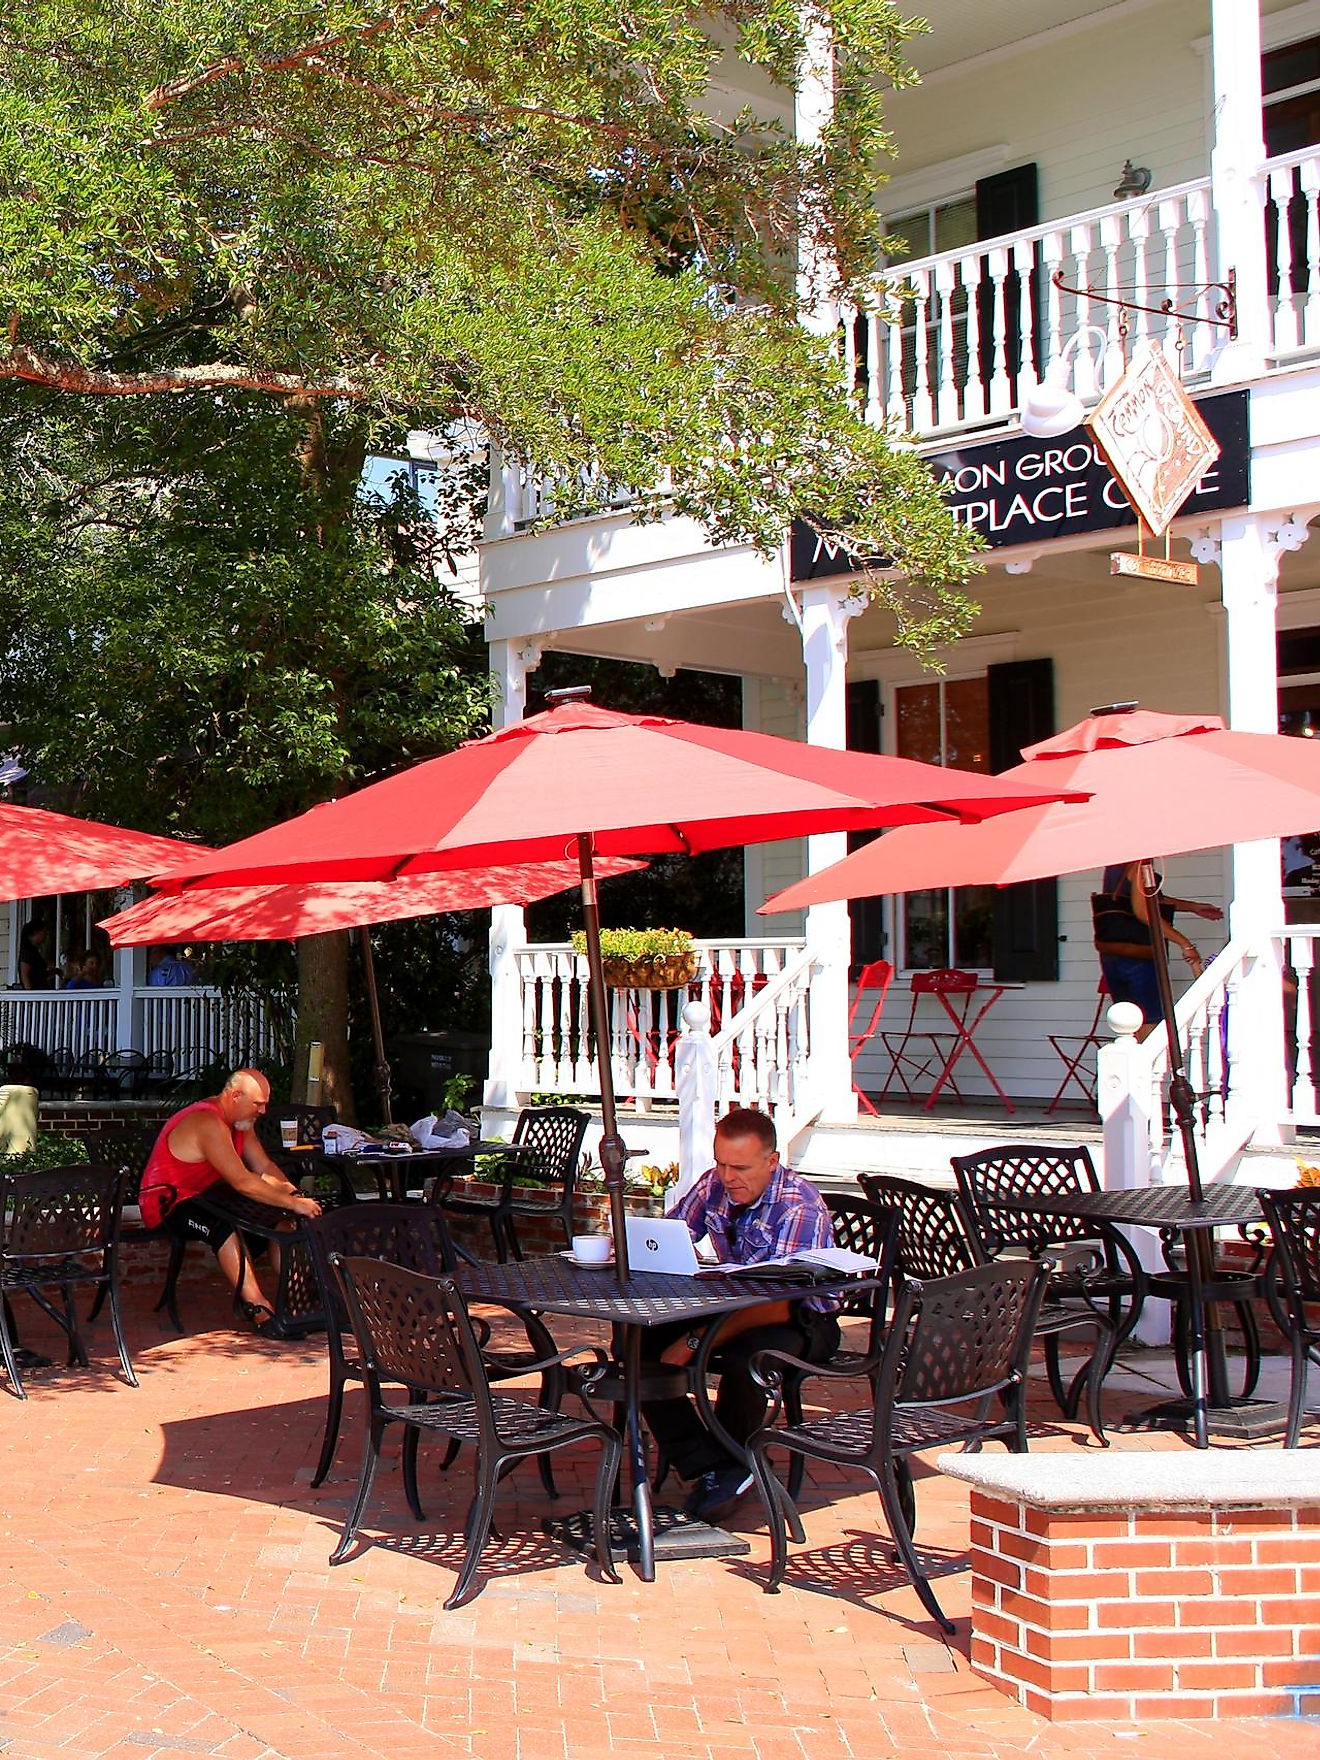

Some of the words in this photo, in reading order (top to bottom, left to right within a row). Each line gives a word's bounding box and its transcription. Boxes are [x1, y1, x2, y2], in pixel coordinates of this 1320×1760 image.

[1107, 378, 1154, 437] COMMON
[1155, 381, 1202, 456] GROUND
[1015, 443, 1108, 481] GROU
[1103, 454, 1220, 509] CE
[646, 1239, 659, 1252] hp
